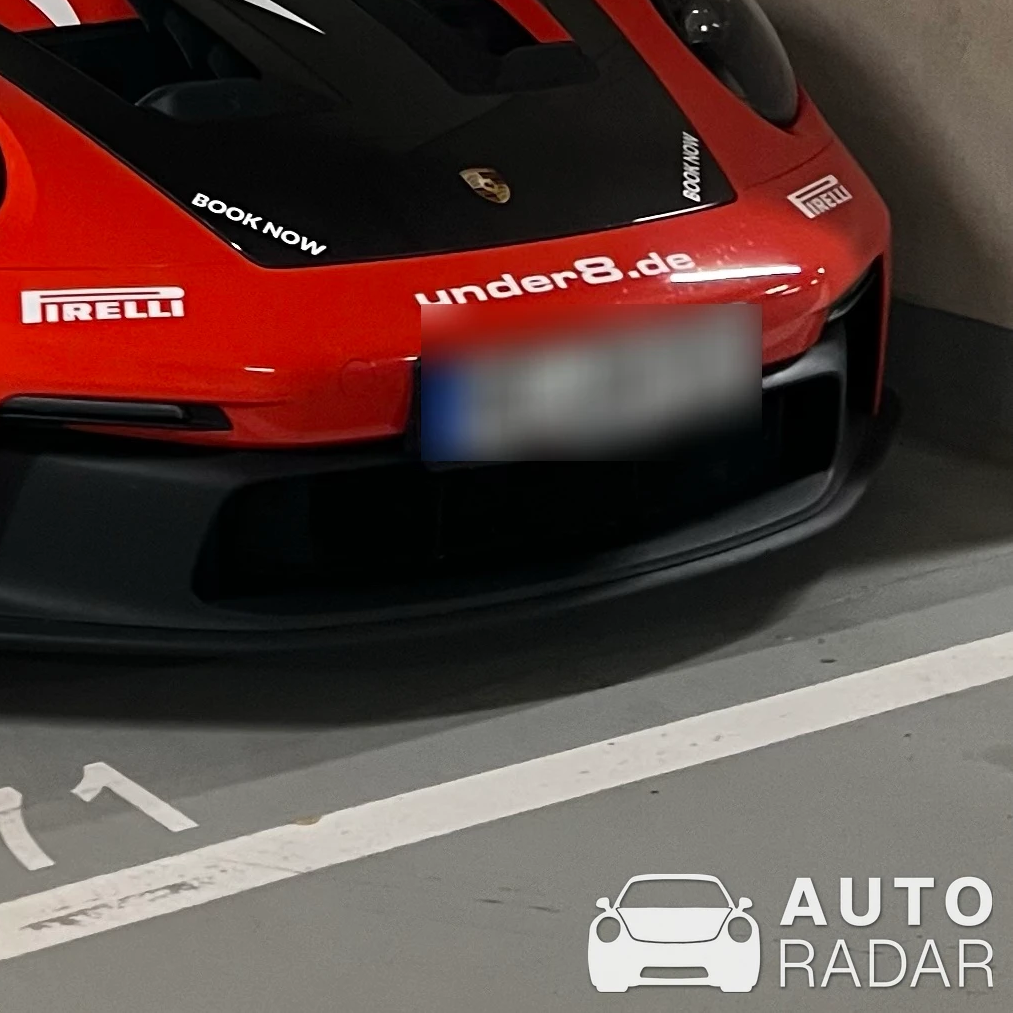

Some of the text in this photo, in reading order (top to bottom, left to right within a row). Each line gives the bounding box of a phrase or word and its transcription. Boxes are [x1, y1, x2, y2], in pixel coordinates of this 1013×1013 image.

[682, 131, 701, 202] BOOK NOW
[787, 174, 852, 219] PIRELLI
[191, 192, 327, 256] BOOK NOW
[21, 287, 185, 324] PIRELLI
[415, 252, 696, 306] under8.de
